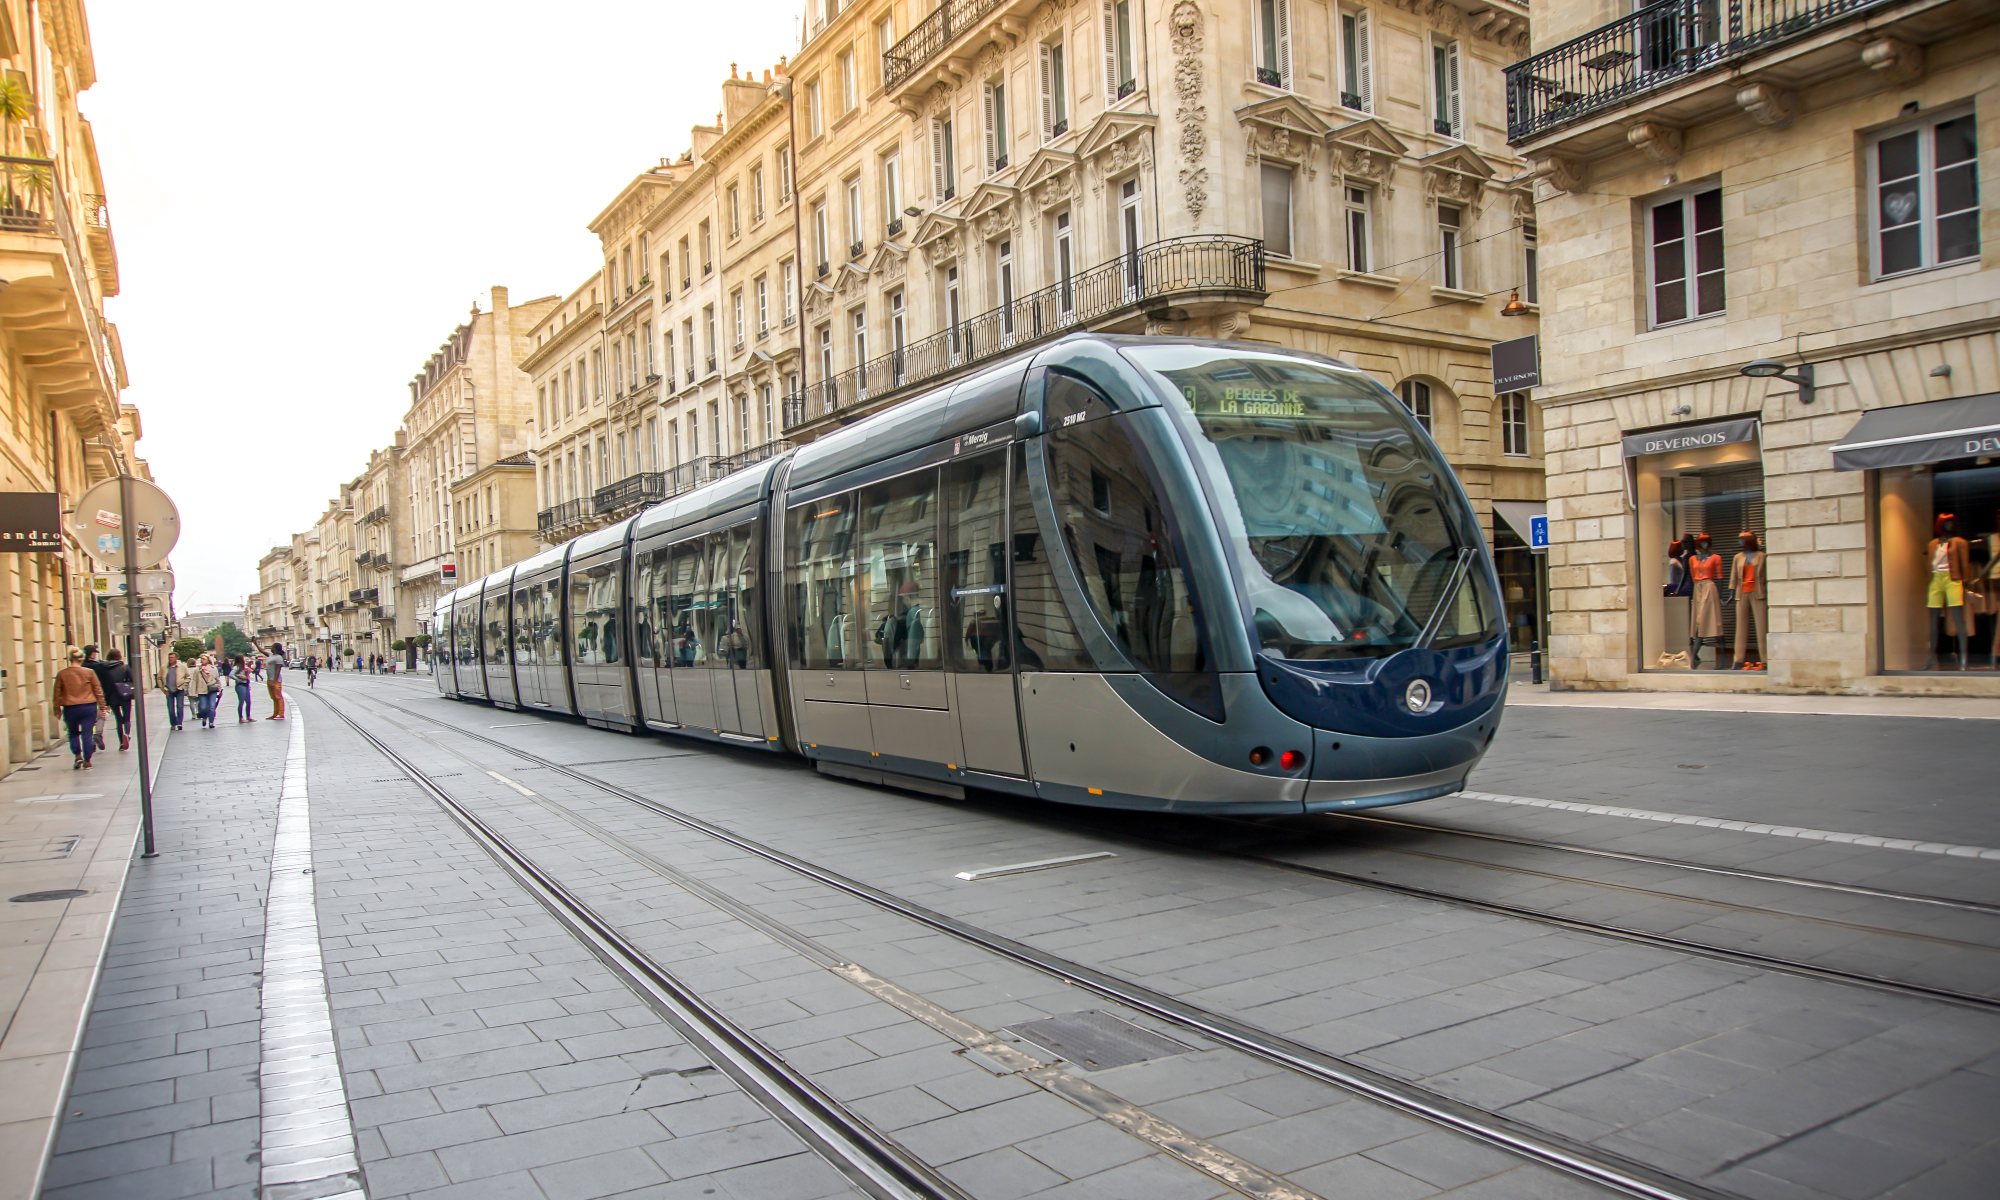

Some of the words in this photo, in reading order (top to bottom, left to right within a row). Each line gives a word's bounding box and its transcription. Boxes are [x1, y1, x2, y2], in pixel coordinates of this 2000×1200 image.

[1494, 371, 1537, 385] DEVERNOIS
[1225, 387, 1277, 402] BERGES
[1283, 389, 1300, 403] DE
[1220, 400, 1238, 414] LA
[1243, 401, 1305, 416] GARONNE
[969, 431, 988, 445] Merzig
[1645, 431, 1726, 452] DEVERNOIS
